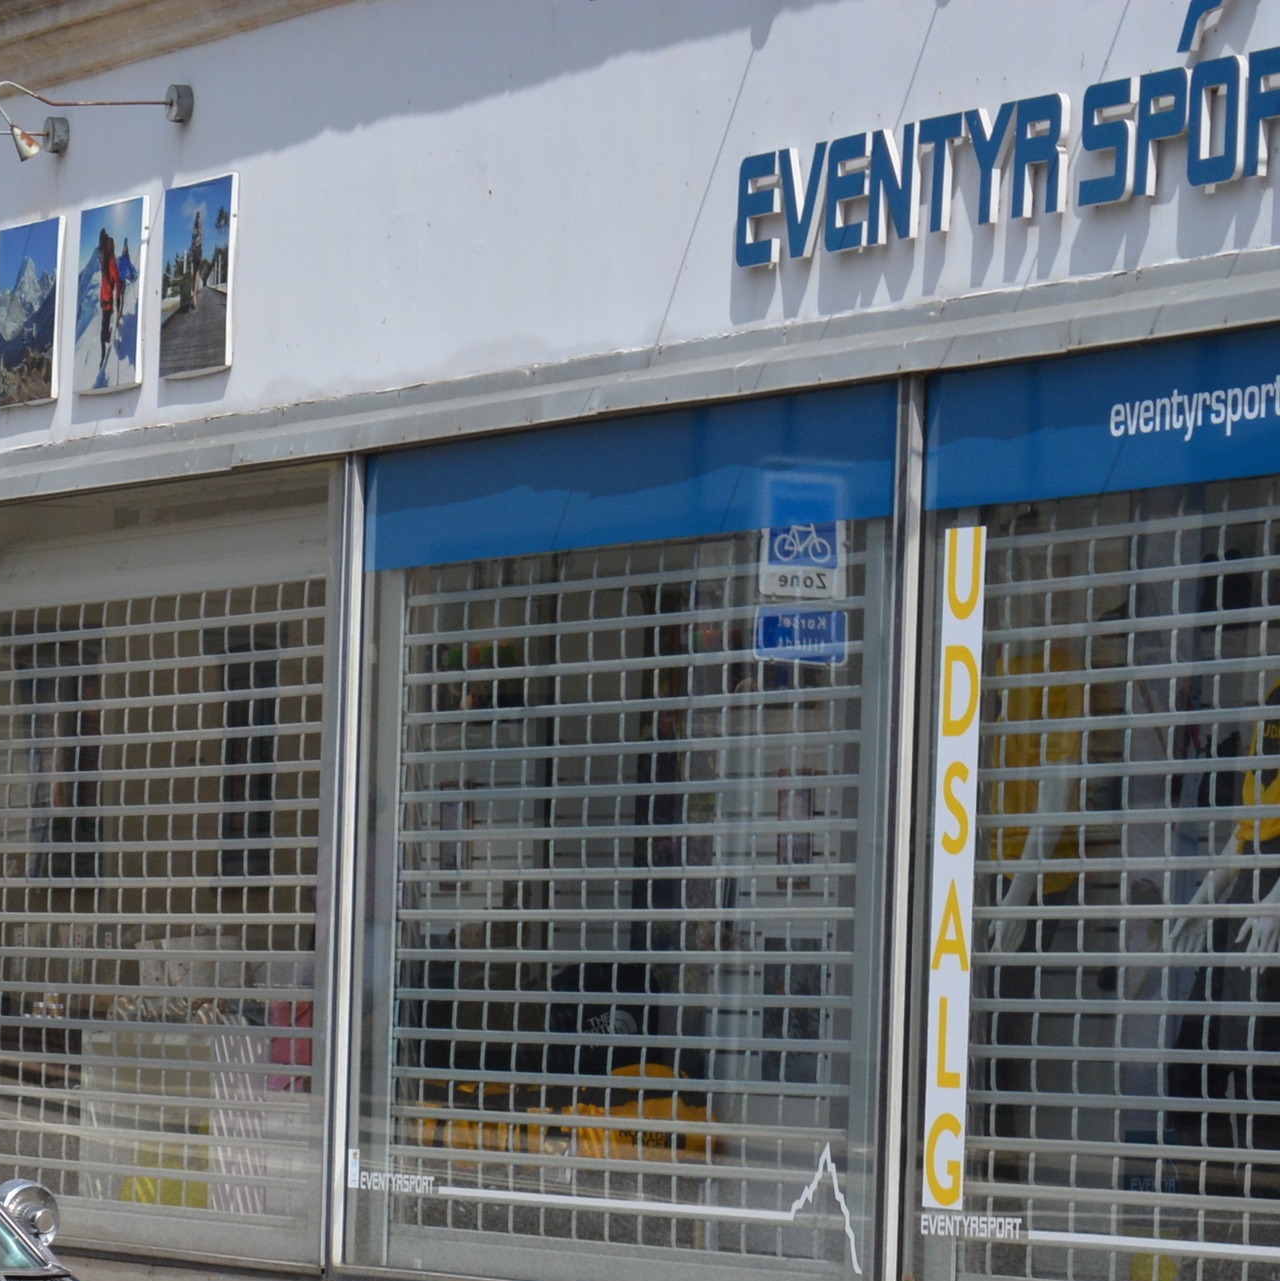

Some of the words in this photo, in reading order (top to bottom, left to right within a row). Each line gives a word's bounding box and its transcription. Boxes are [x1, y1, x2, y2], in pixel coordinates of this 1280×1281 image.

[736, 92, 1070, 267] EVENTYR
[926, 526, 982, 1206] UDSALG
[921, 1214, 1022, 1239] EVENTYRSPORT
